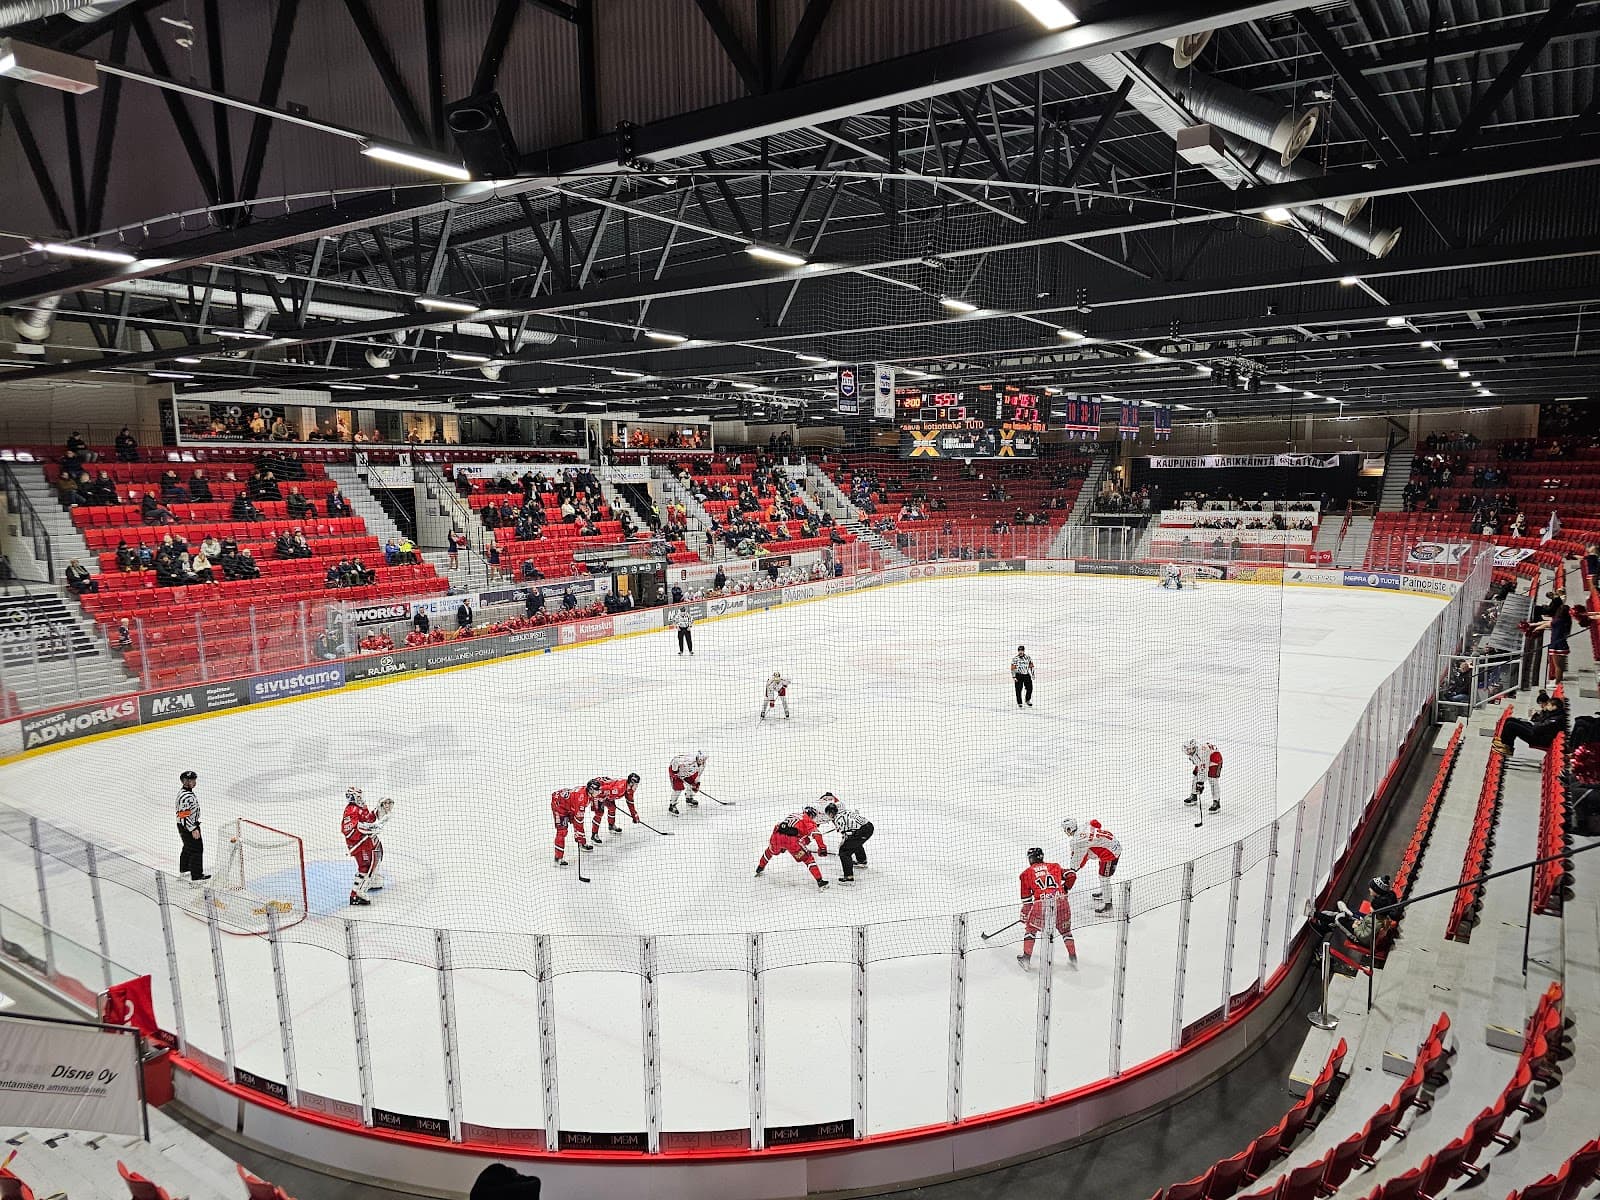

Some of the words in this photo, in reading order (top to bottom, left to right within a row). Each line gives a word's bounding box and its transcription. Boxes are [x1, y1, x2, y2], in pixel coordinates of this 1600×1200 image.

[1156, 458, 1206, 468] KAUPUNGIN
[1402, 576, 1447, 592] Painopiste
[255, 670, 340, 694] sivustamo
[152, 693, 196, 714] M&M
[26, 700, 136, 749] ADWORKS
[1035, 874, 1058, 890] 14
[51, 1065, 94, 1080] Disne
[98, 1068, 118, 1085] Oy
